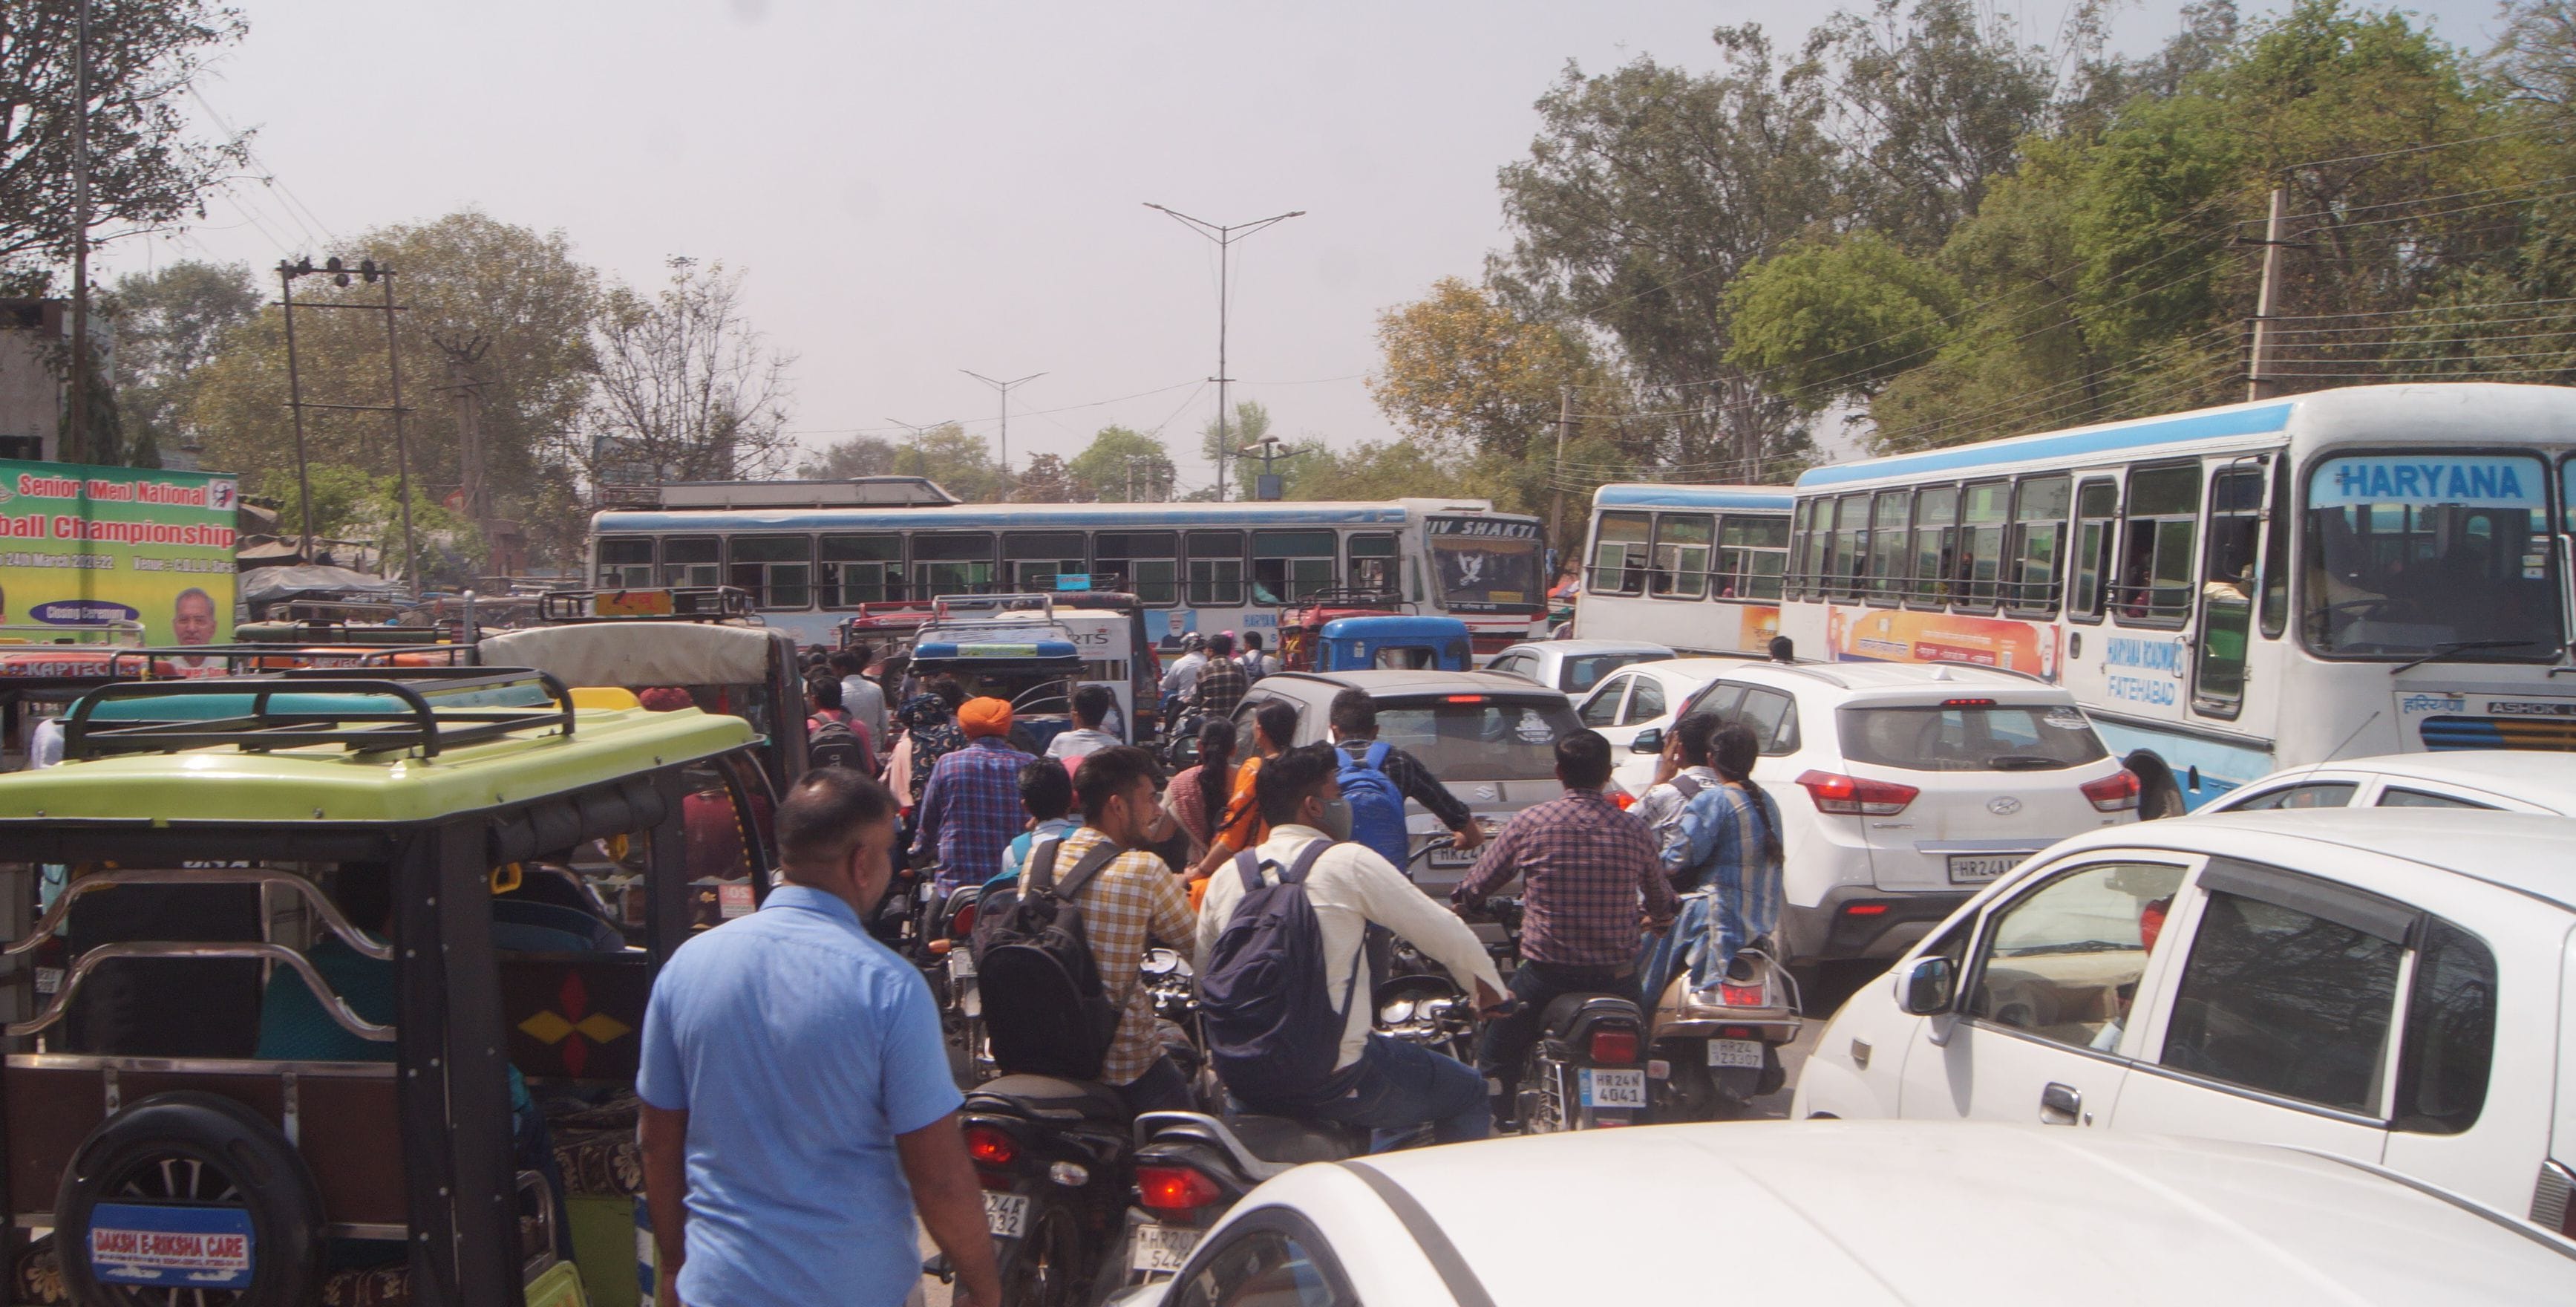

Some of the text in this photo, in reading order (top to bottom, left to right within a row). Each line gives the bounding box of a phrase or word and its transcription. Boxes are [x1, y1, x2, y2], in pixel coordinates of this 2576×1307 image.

[19, 474, 207, 506] Senior (Men) National
[2341, 464, 2523, 498] HARYANA
[53, 515, 236, 549] Championship
[1460, 521, 1537, 538] SHAKTI
[47, 606, 81, 620] Closing
[2108, 675, 2175, 706] FATEHABAD
[2491, 703, 2558, 714] ASHOK
[1599, 1088, 1639, 1103] 4041
[96, 1231, 243, 1258] DAKSH E-RIKSHA CARE
